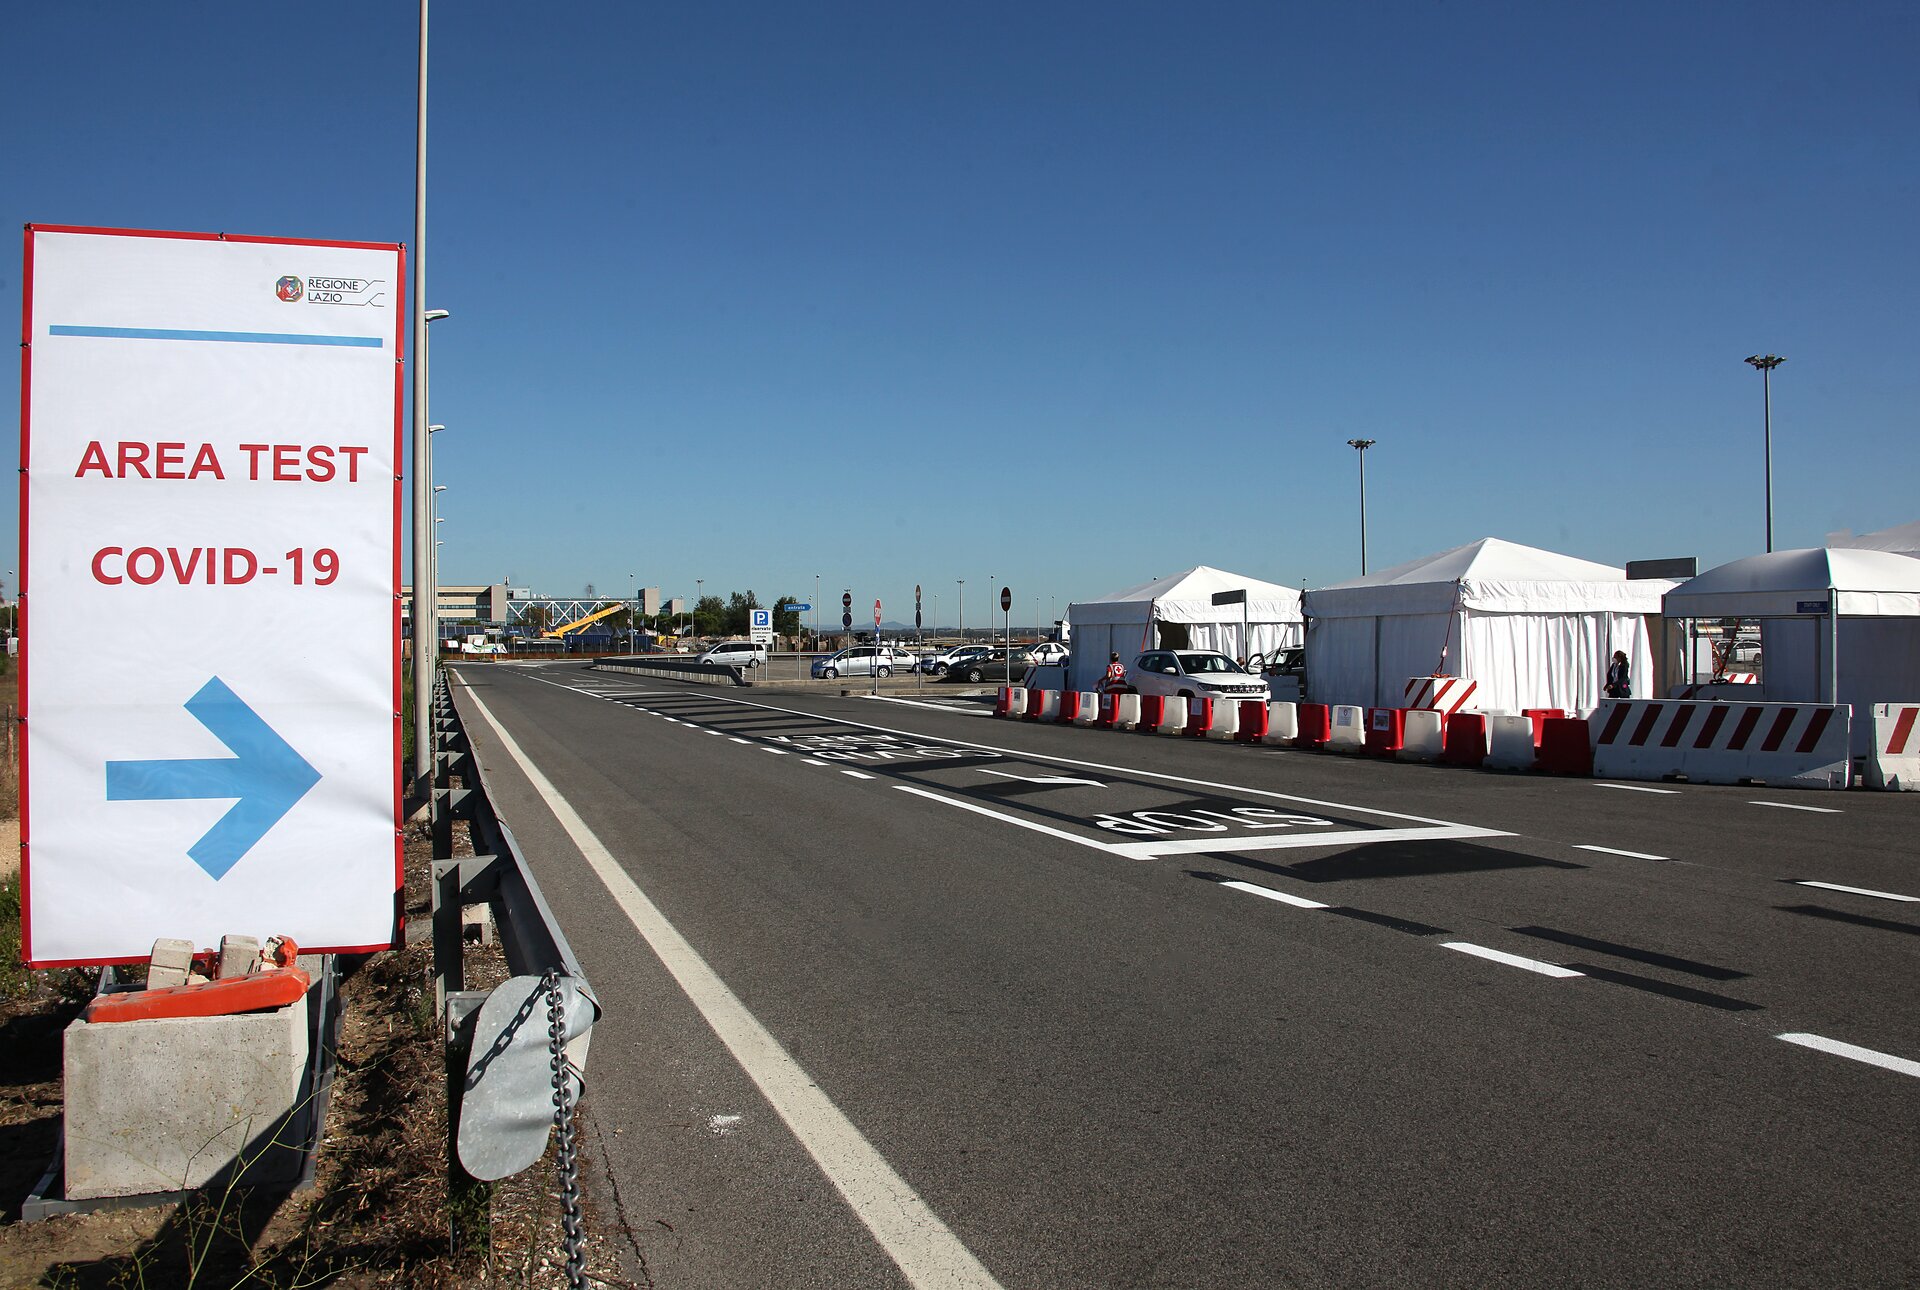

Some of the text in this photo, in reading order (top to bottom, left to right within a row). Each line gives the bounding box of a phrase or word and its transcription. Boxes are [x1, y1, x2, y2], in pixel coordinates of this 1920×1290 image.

[308, 278, 359, 291] REGIONE
[308, 292, 343, 303] LAZIO
[74, 440, 369, 483] AREA TEST
[91, 546, 340, 586] COVID-19
[756, 612, 766, 625] P
[762, 735, 897, 743] AREA
[793, 742, 941, 750] TEST
[814, 749, 1004, 759] COVID
[1093, 807, 1333, 834] STOP
